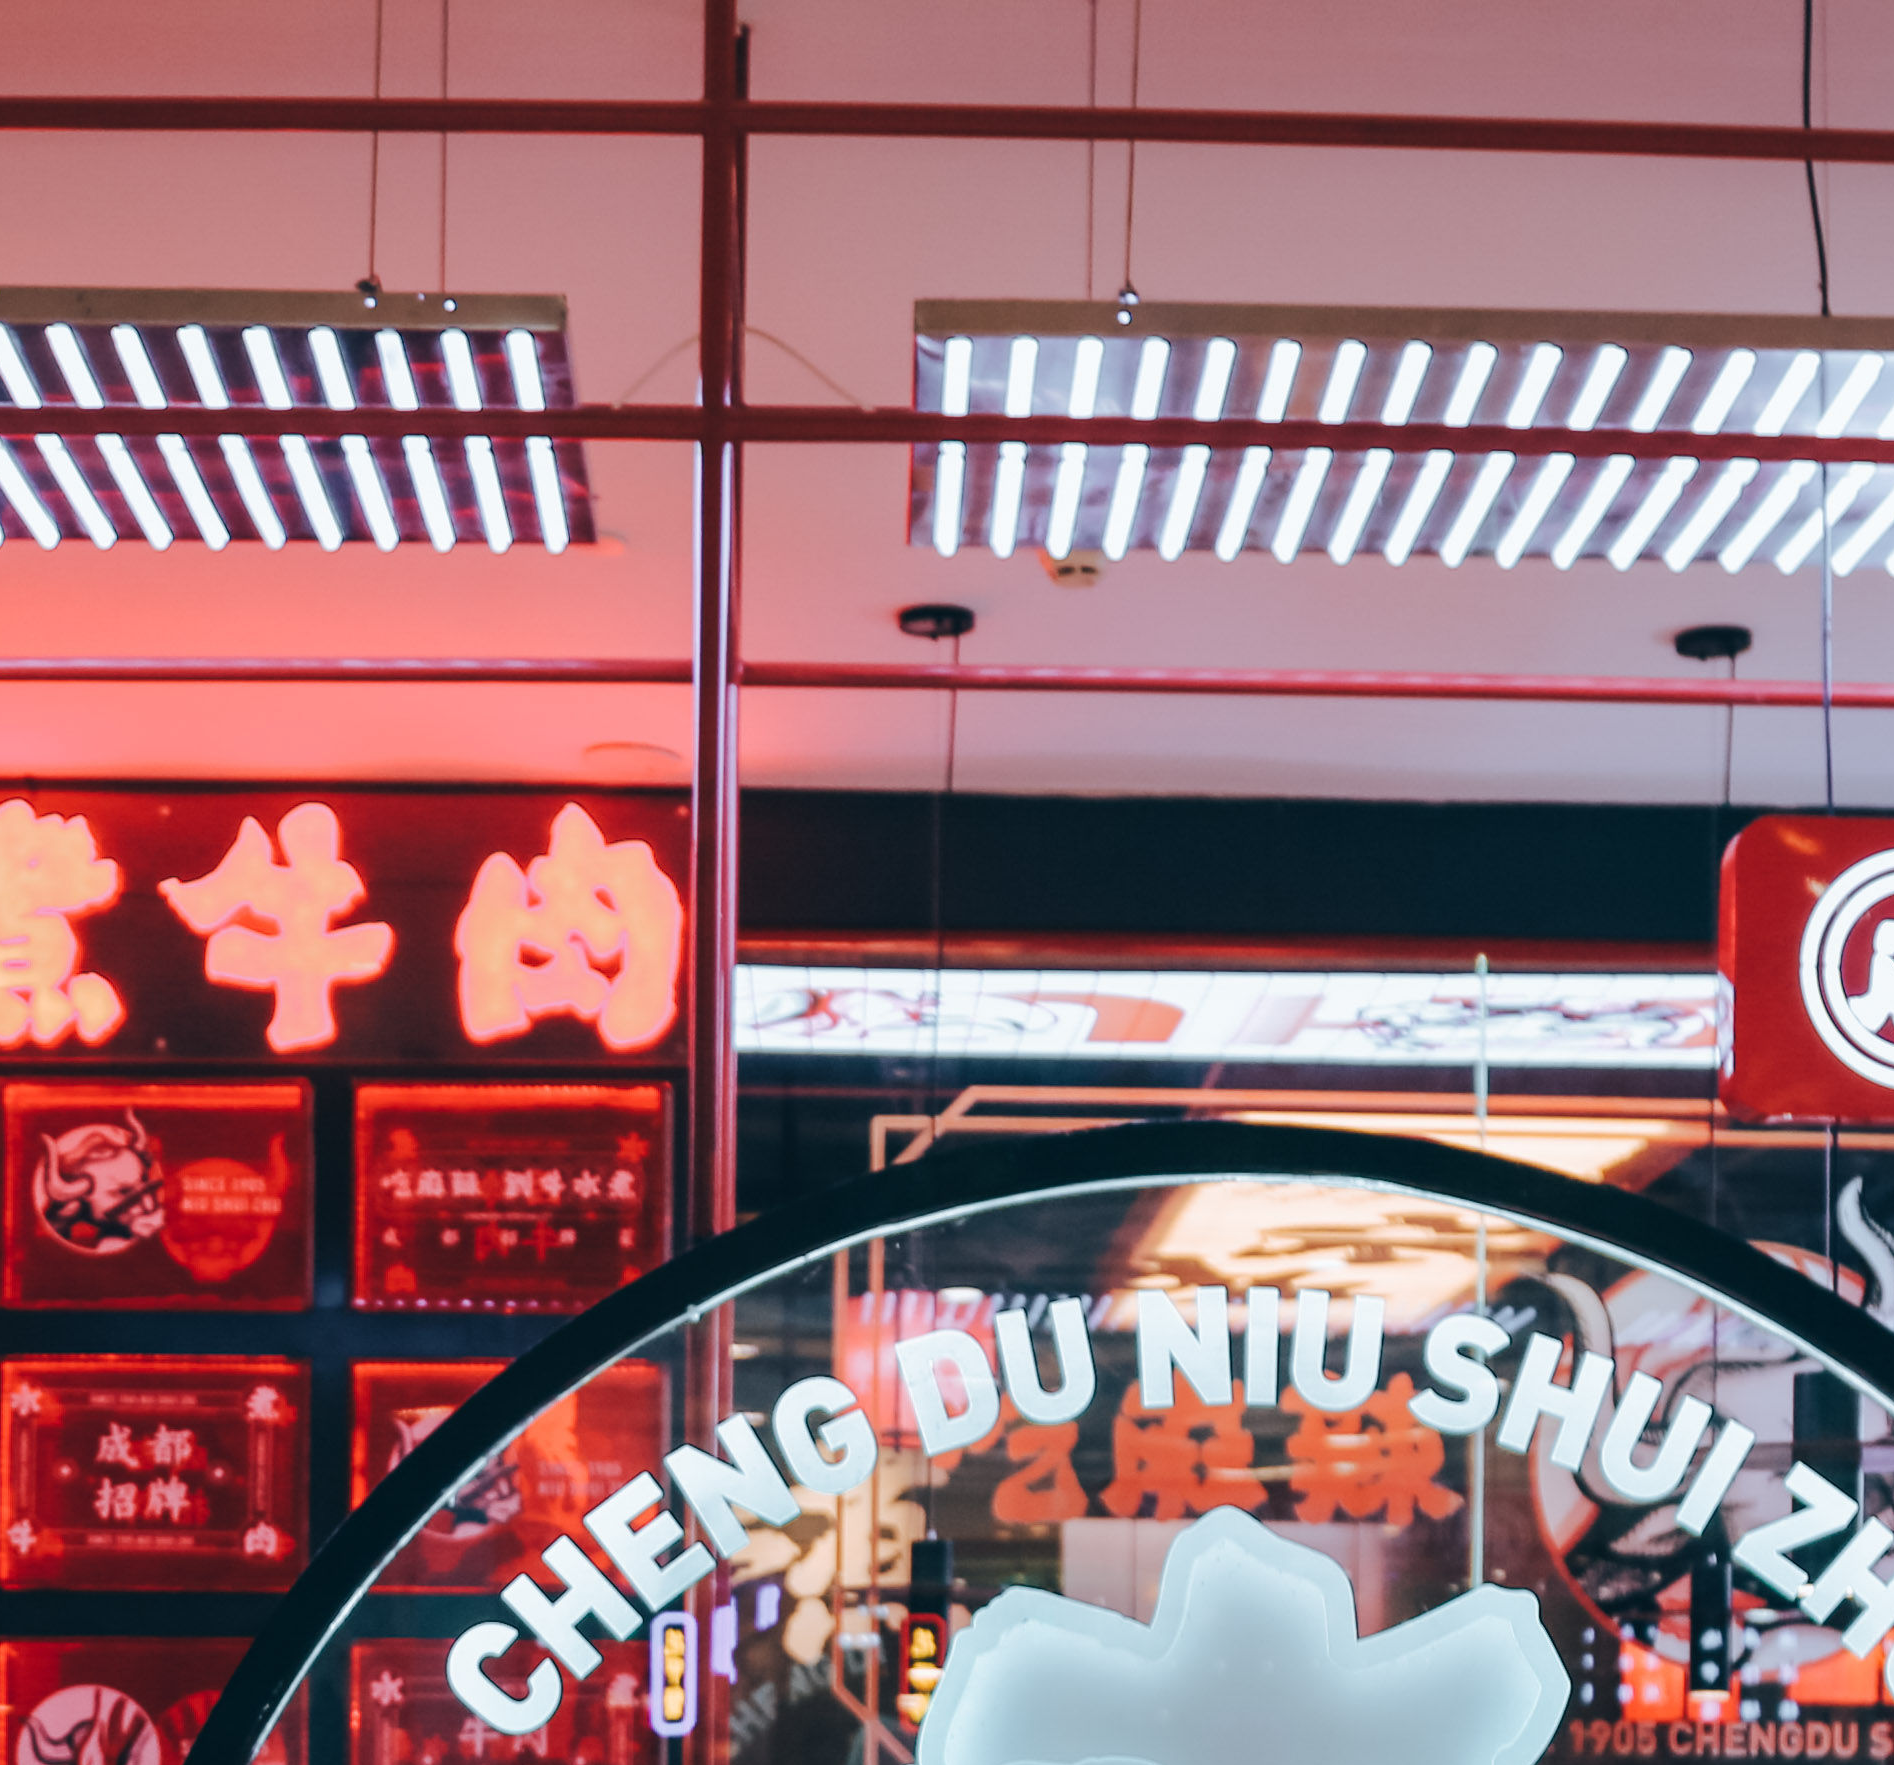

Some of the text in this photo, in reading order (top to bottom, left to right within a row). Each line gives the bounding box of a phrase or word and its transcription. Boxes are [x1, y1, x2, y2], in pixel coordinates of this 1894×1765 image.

[97, 1422, 194, 1469] 成都
[94, 1475, 190, 1523] 招牌
[447, 1376, 878, 1736] CHENG
[896, 1297, 1096, 1458] DU
[1137, 1285, 1385, 1411] NIU
[1408, 1313, 1755, 1537] SHUI
[1570, 1720, 1657, 1756] 1905
[1667, 1720, 1859, 1759] CHENGDU
